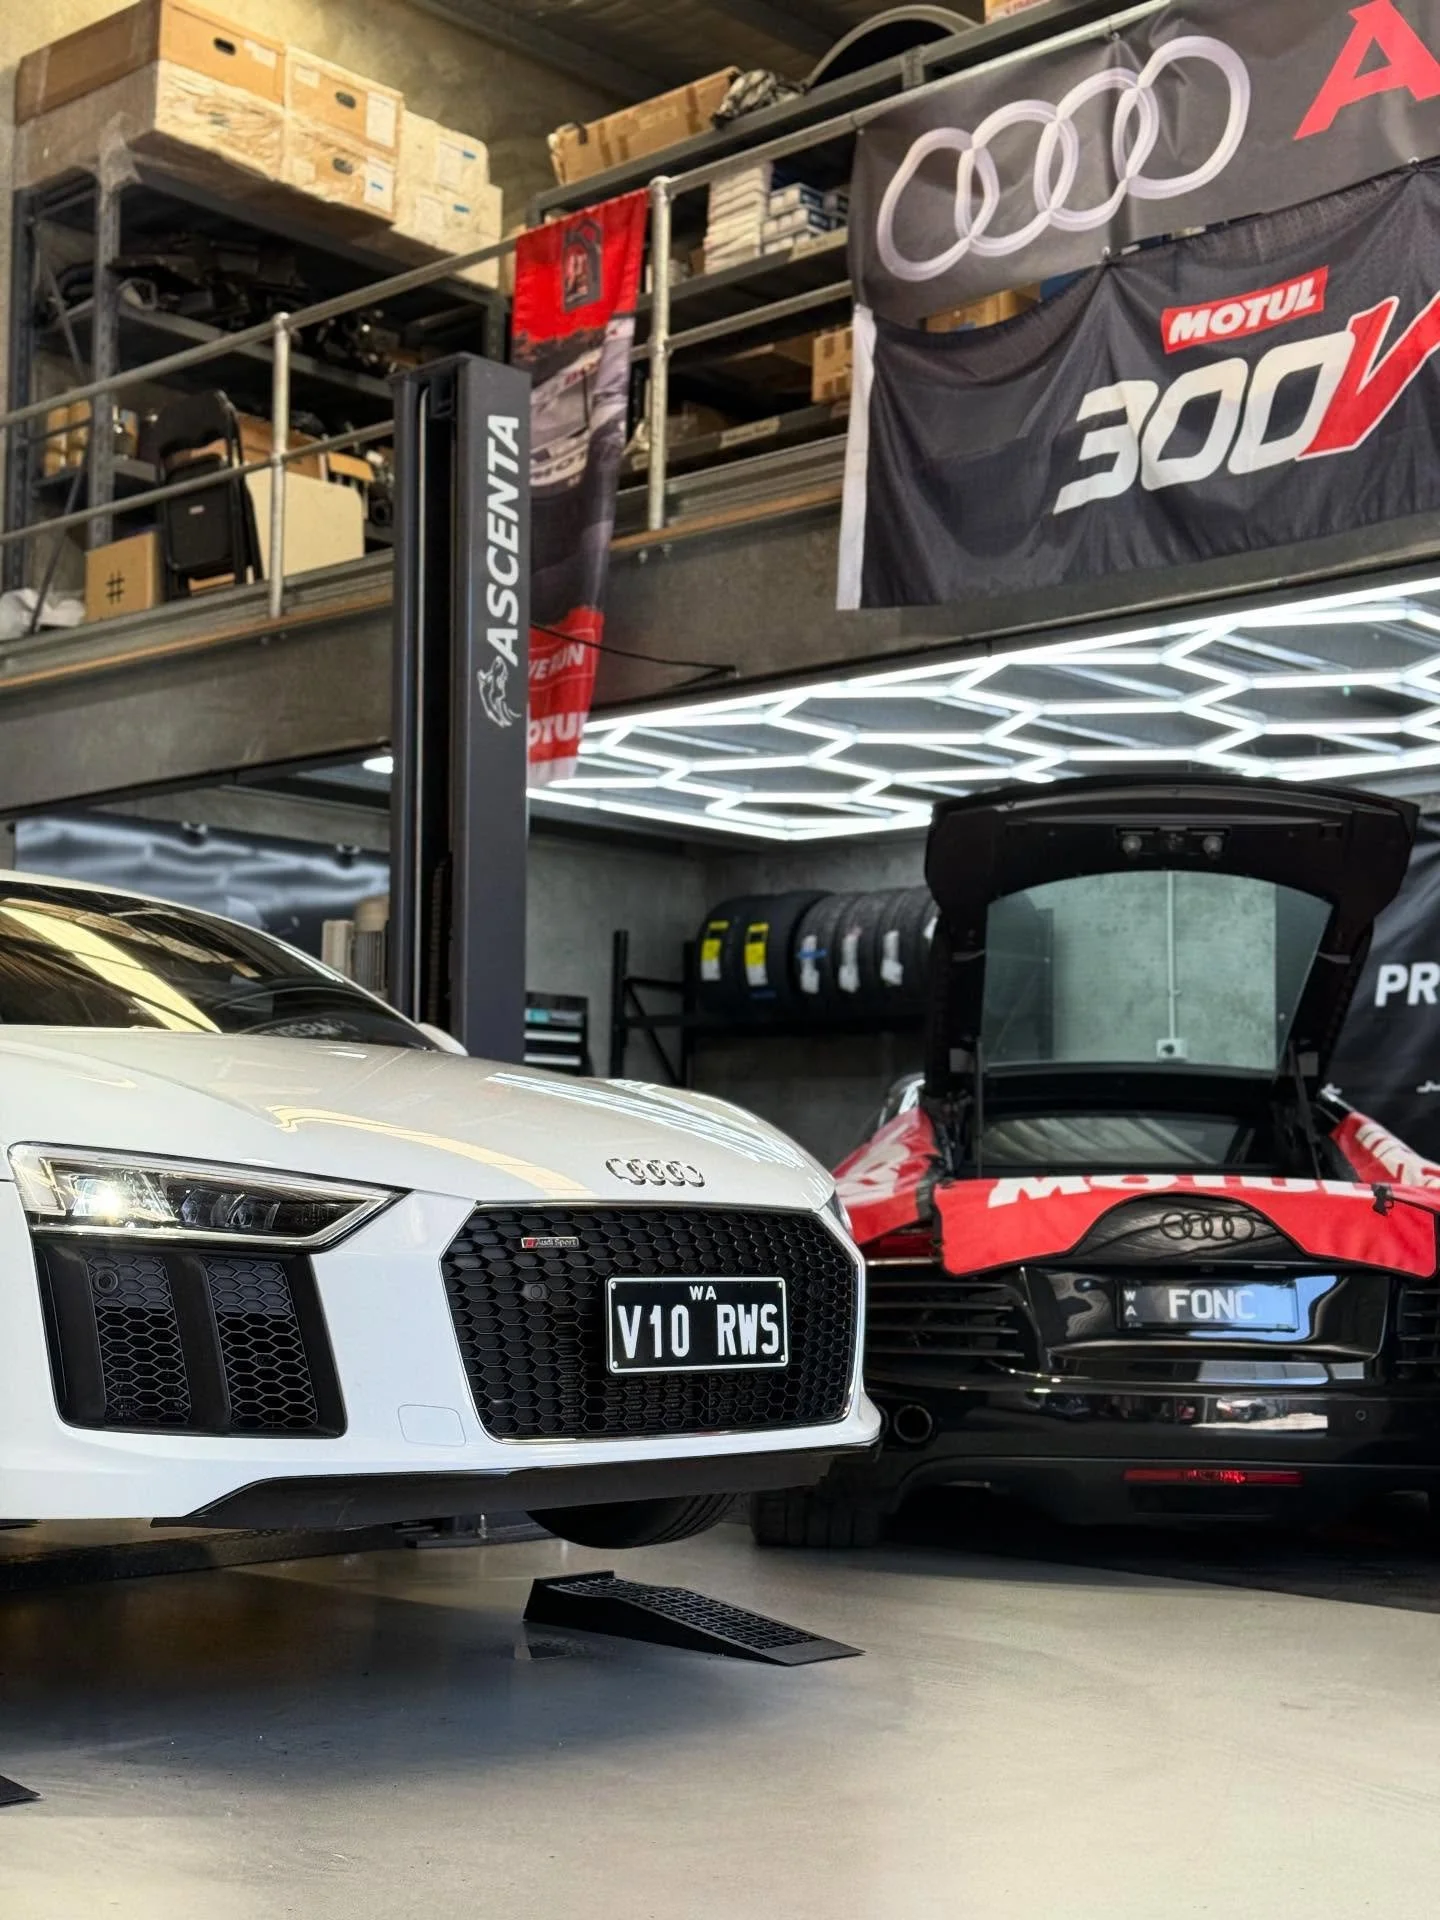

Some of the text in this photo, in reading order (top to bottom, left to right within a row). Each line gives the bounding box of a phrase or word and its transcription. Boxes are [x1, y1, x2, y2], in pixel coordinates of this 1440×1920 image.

[1293, 0, 1440, 140] A
[1168, 278, 1316, 345] MOTUL
[1053, 292, 1440, 515] 300V
[486, 415, 519, 667] ASCENTA
[1375, 962, 1440, 1008] PR
[554, 1238, 577, 1248] Sport
[689, 1285, 717, 1301] WA
[617, 1303, 779, 1359] V10 RWS
